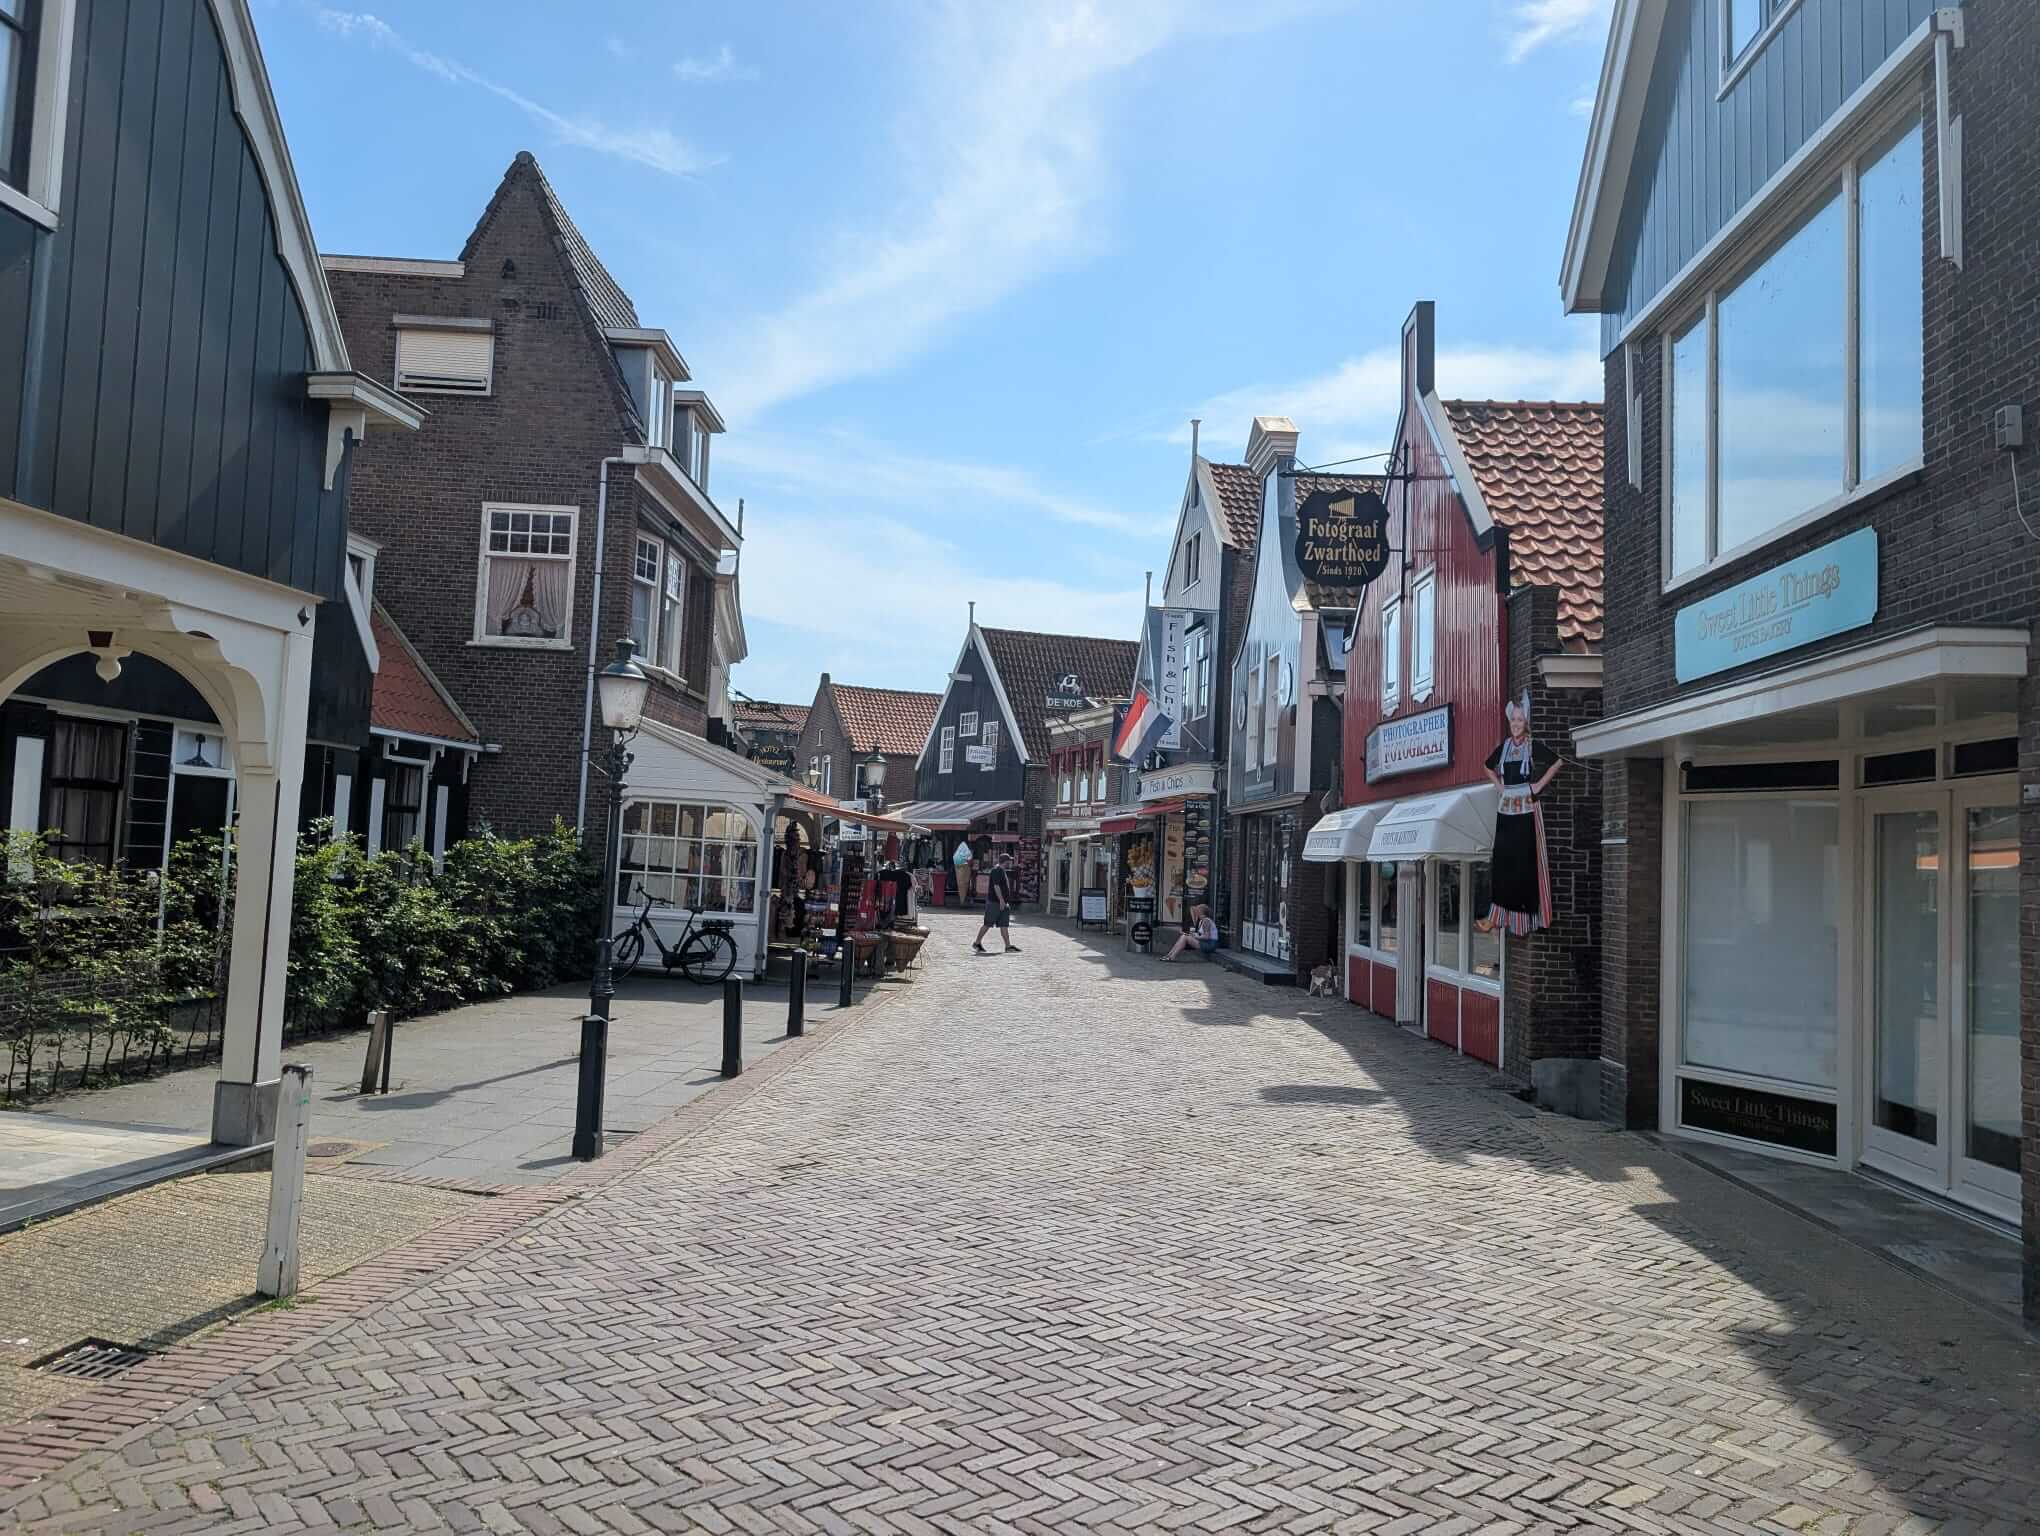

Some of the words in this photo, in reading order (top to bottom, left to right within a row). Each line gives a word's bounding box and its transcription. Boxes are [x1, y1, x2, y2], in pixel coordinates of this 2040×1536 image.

[1308, 518, 1379, 541] Fotograaf
[1304, 541, 1380, 562] Zwarthoed
[1322, 565, 1342, 576] Sinds
[1345, 566, 1362, 576] 1920
[1697, 607, 1738, 640] Sweet
[1738, 584, 1778, 625] Little
[1780, 564, 1840, 609] Things
[1047, 697, 1059, 708] DE
[1063, 697, 1083, 708] KOE
[1383, 712, 1446, 742] PHOTOGRAPHER
[1383, 733, 1447, 764] FOTOGRAAF
[1167, 775, 1184, 791] Chips
[1690, 1088, 1731, 1111] Sweet
[1735, 1097, 1772, 1119] Little
[1774, 1103, 1831, 1133] Things
